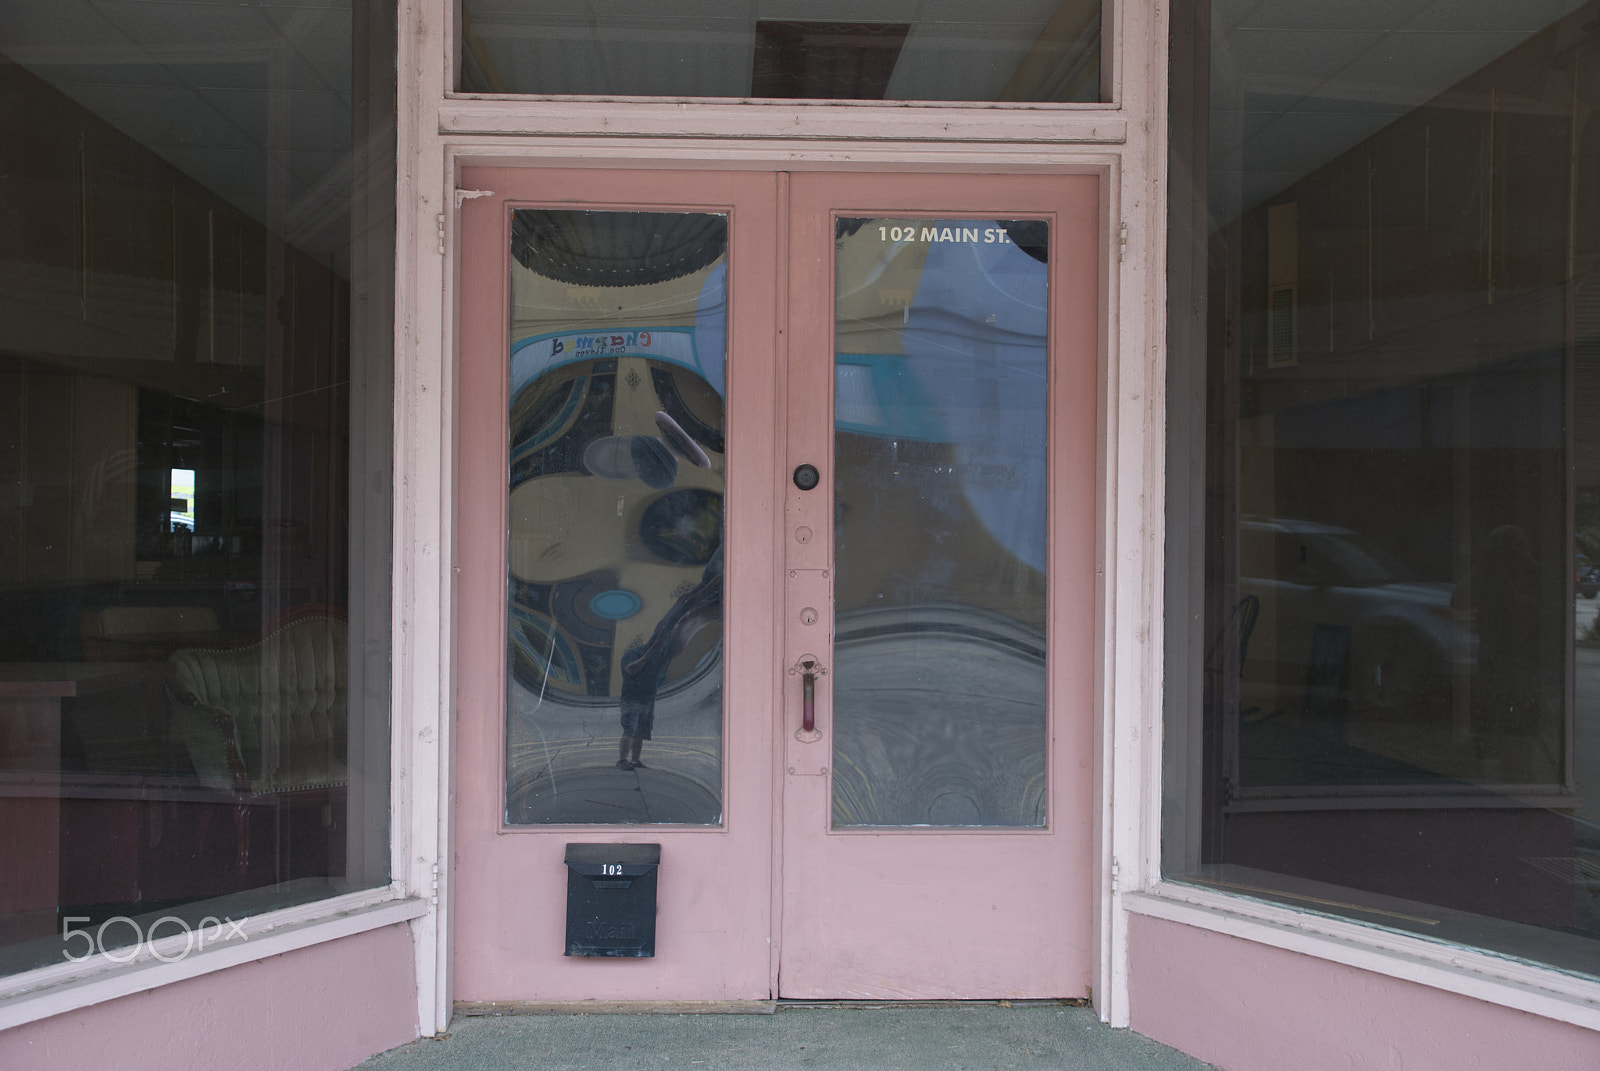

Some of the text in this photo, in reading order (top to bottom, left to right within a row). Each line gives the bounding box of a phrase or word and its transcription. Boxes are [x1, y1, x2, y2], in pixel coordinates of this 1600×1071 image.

[878, 226, 1010, 244] 102 MAIN ST.
[602, 863, 622, 876] 102
[586, 921, 636, 939] Mail
